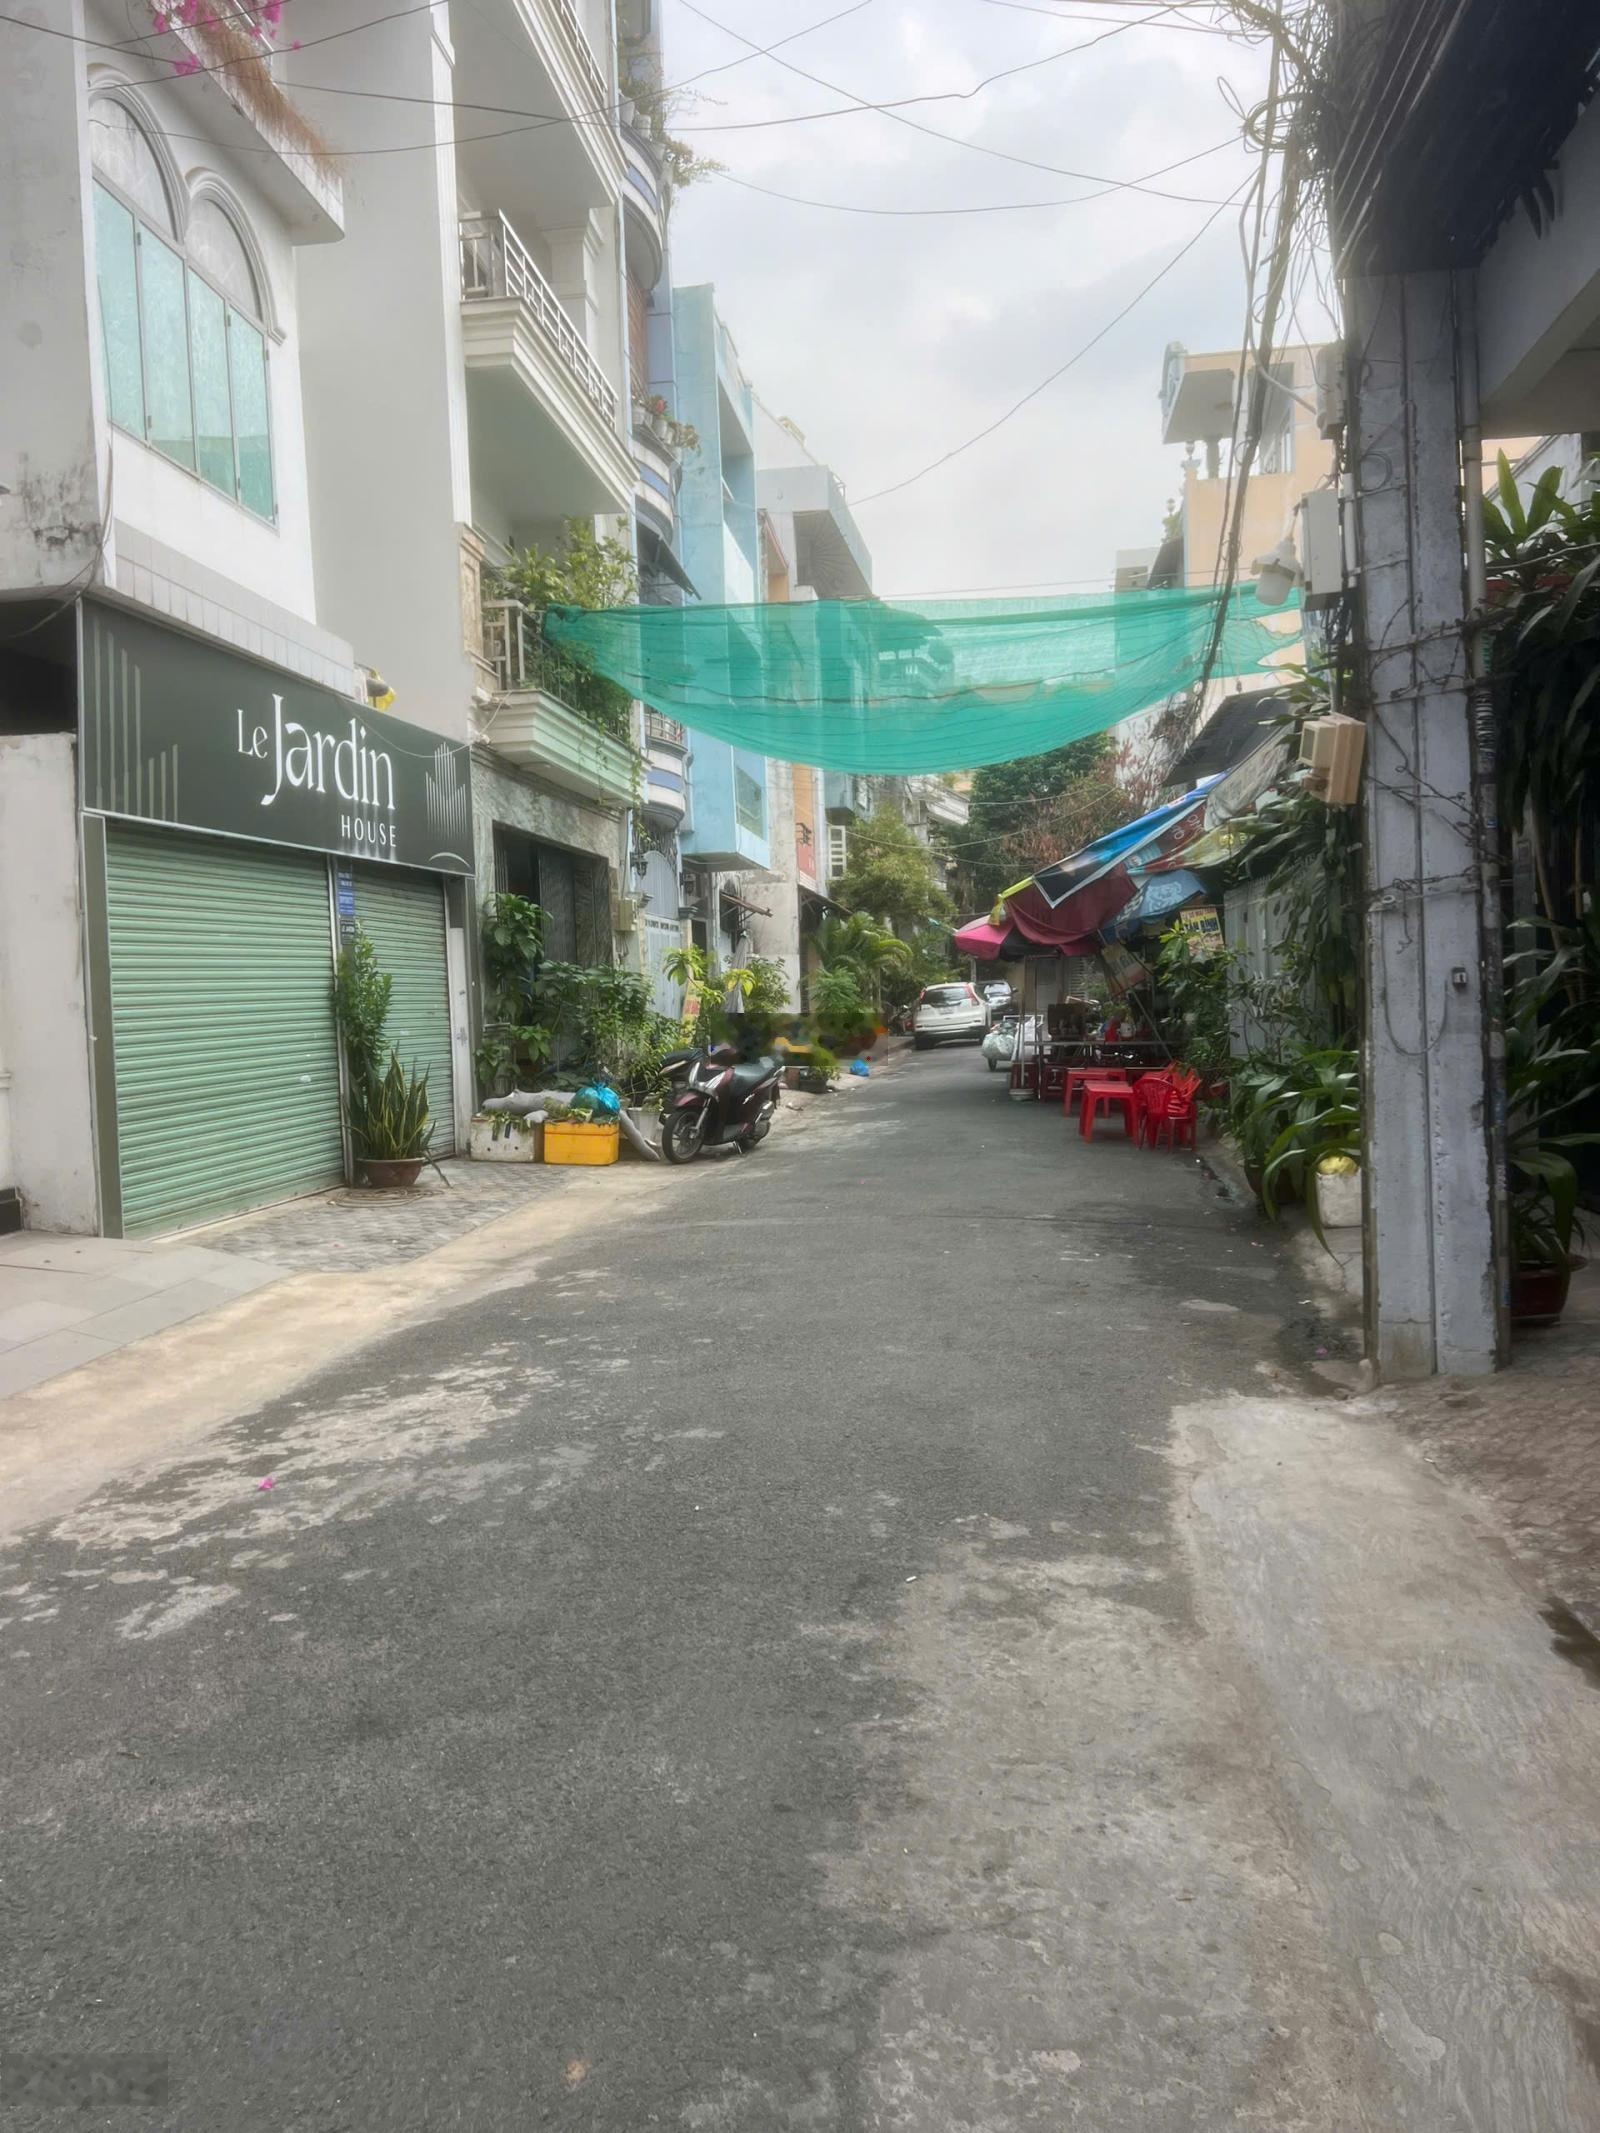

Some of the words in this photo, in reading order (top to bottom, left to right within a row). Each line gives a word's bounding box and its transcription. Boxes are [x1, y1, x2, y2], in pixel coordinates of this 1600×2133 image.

[237, 709, 268, 758] Le
[260, 693, 396, 810] Jardin
[341, 814, 396, 847] HOUSE
